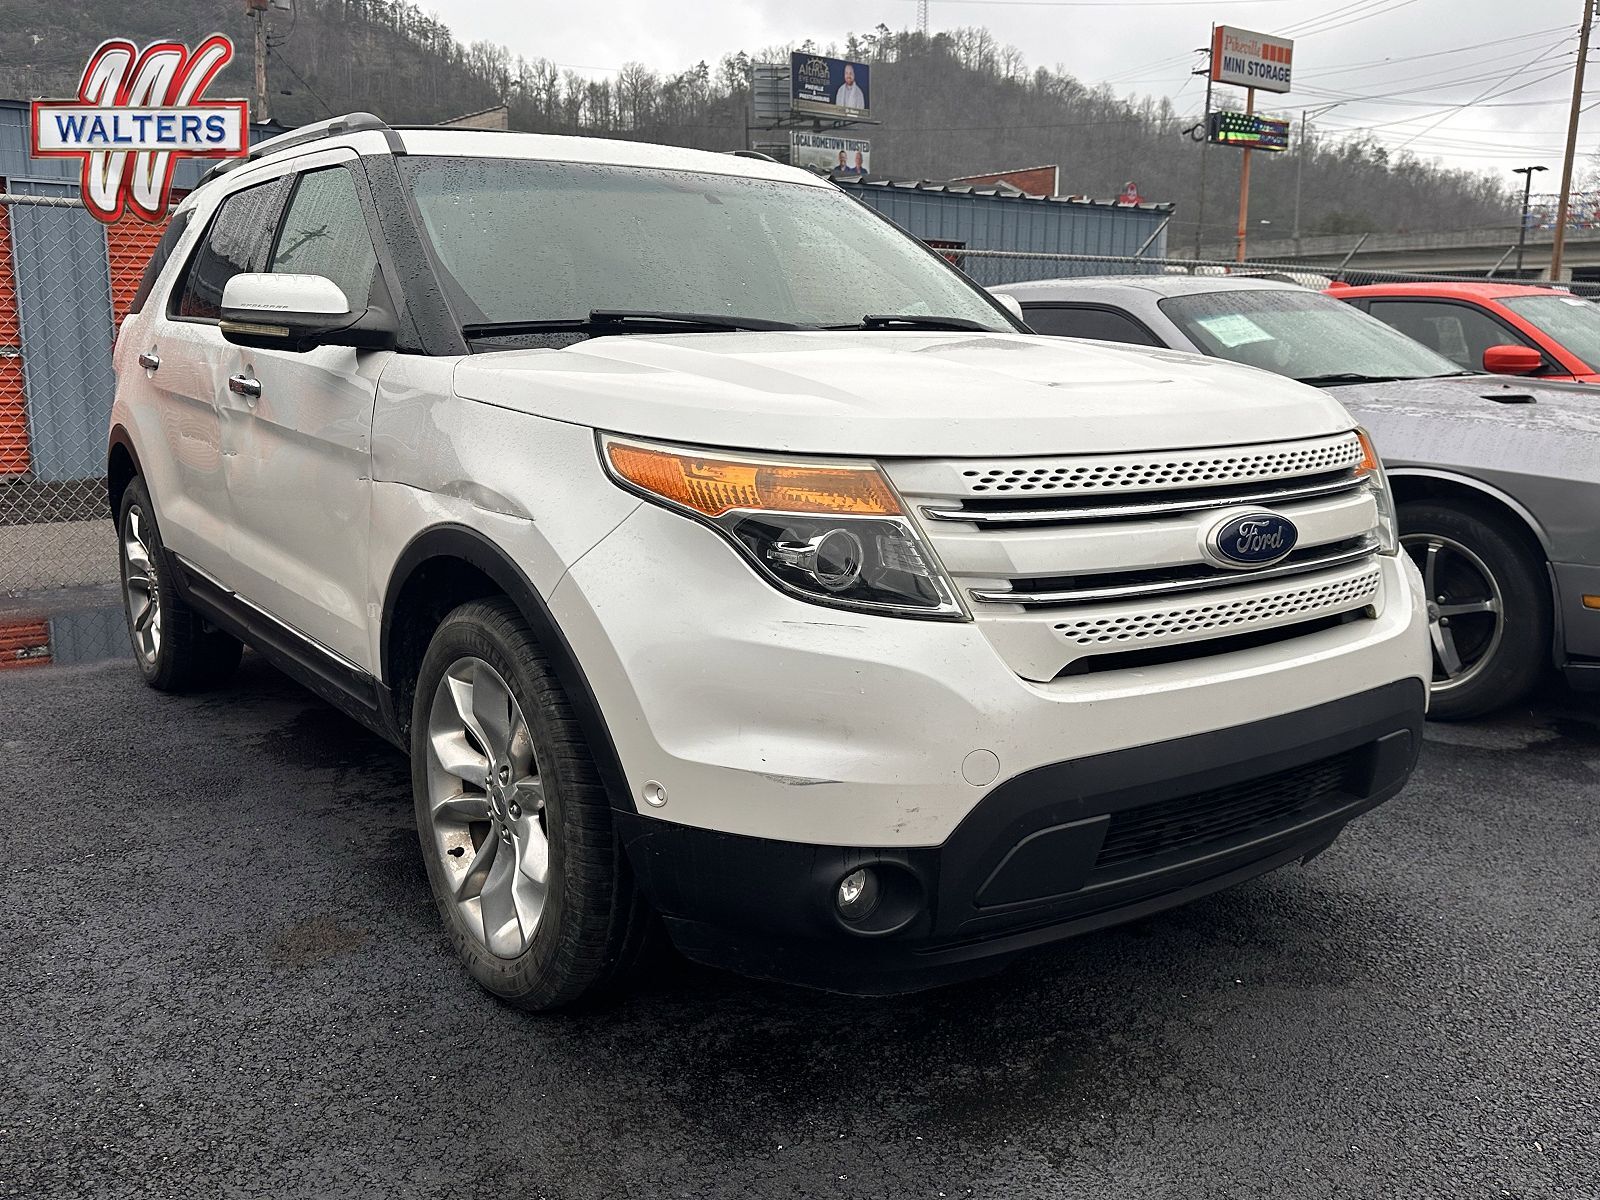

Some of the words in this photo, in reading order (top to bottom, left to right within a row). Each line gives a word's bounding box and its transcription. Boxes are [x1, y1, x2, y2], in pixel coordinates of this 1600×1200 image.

[798, 64, 830, 79] Altman
[1224, 56, 1245, 74] MINI
[1248, 61, 1291, 83] STORAGE
[792, 133, 811, 148] LOCAL
[811, 135, 845, 151] HOMETOWN
[1236, 520, 1284, 554] Ford
